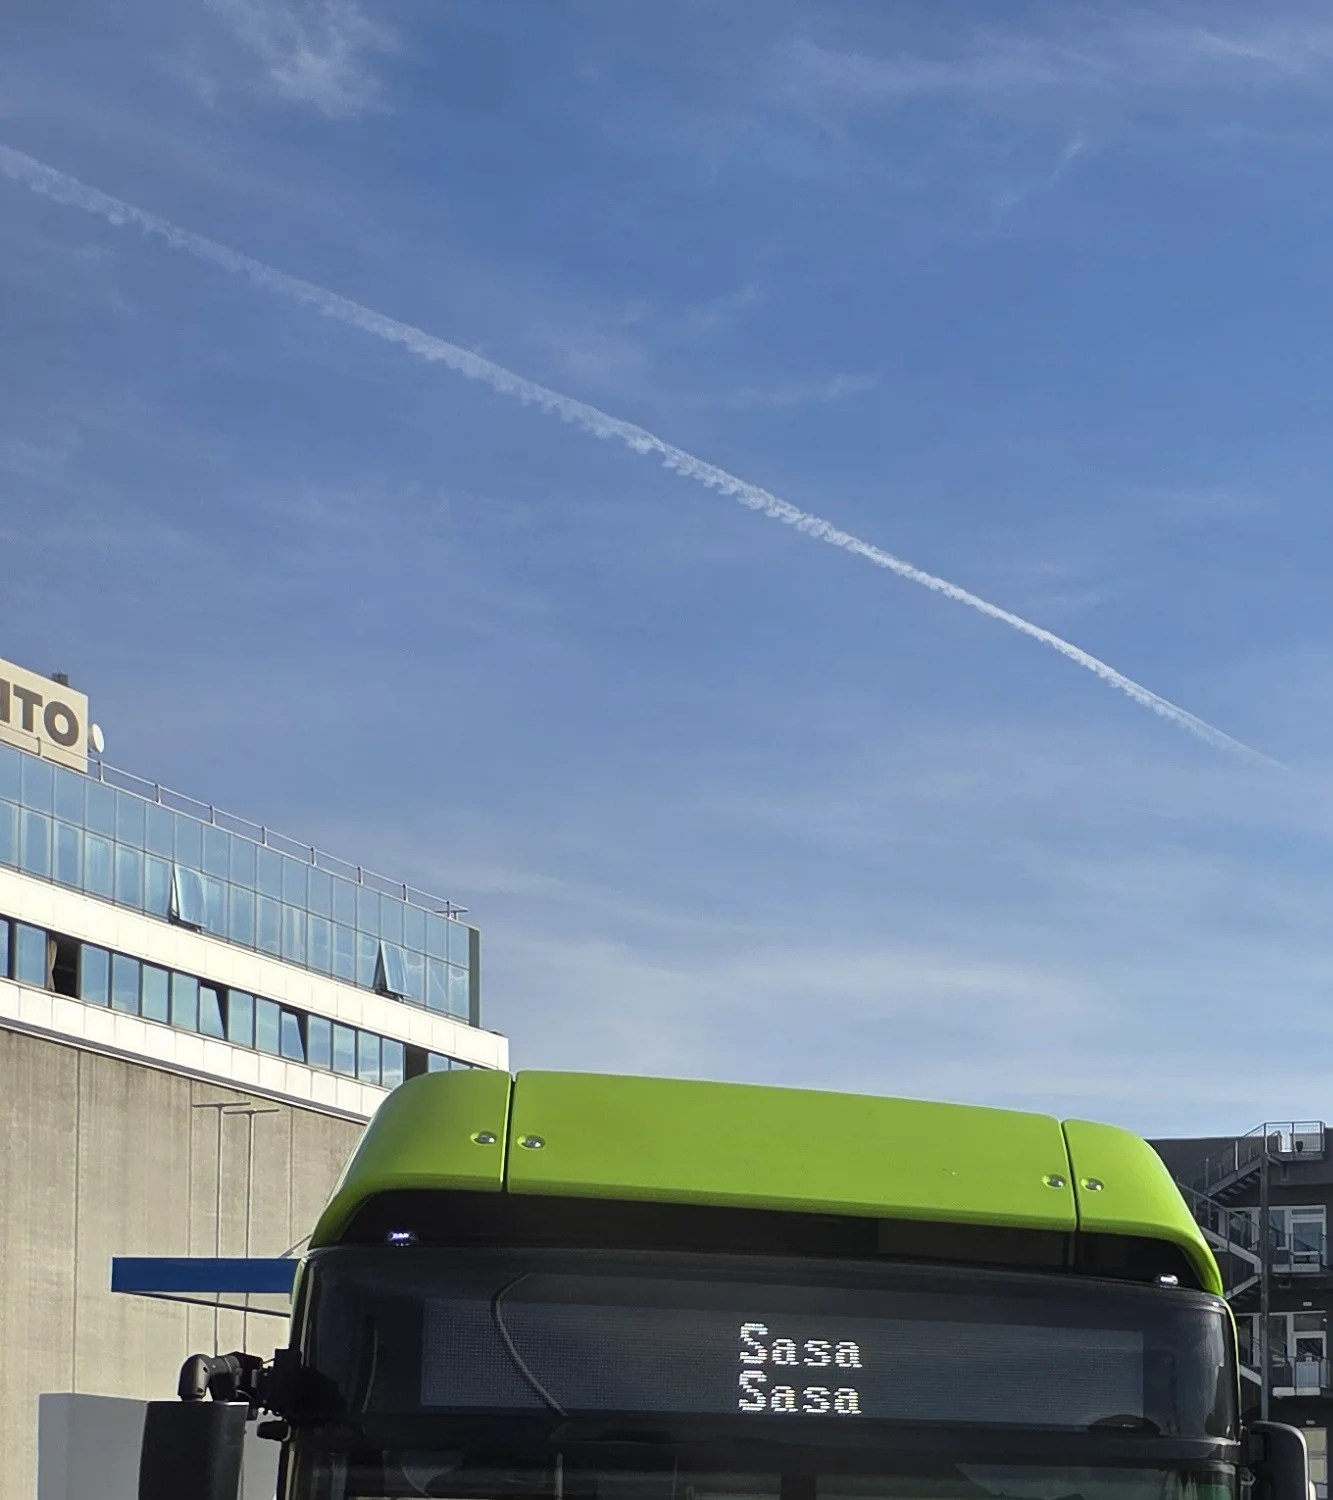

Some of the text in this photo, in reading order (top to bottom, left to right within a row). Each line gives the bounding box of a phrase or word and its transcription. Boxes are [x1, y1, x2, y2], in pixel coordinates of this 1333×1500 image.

[0, 678, 79, 747] TO
[739, 1322, 863, 1368] Sasa
[738, 1370, 862, 1415] Sasa
